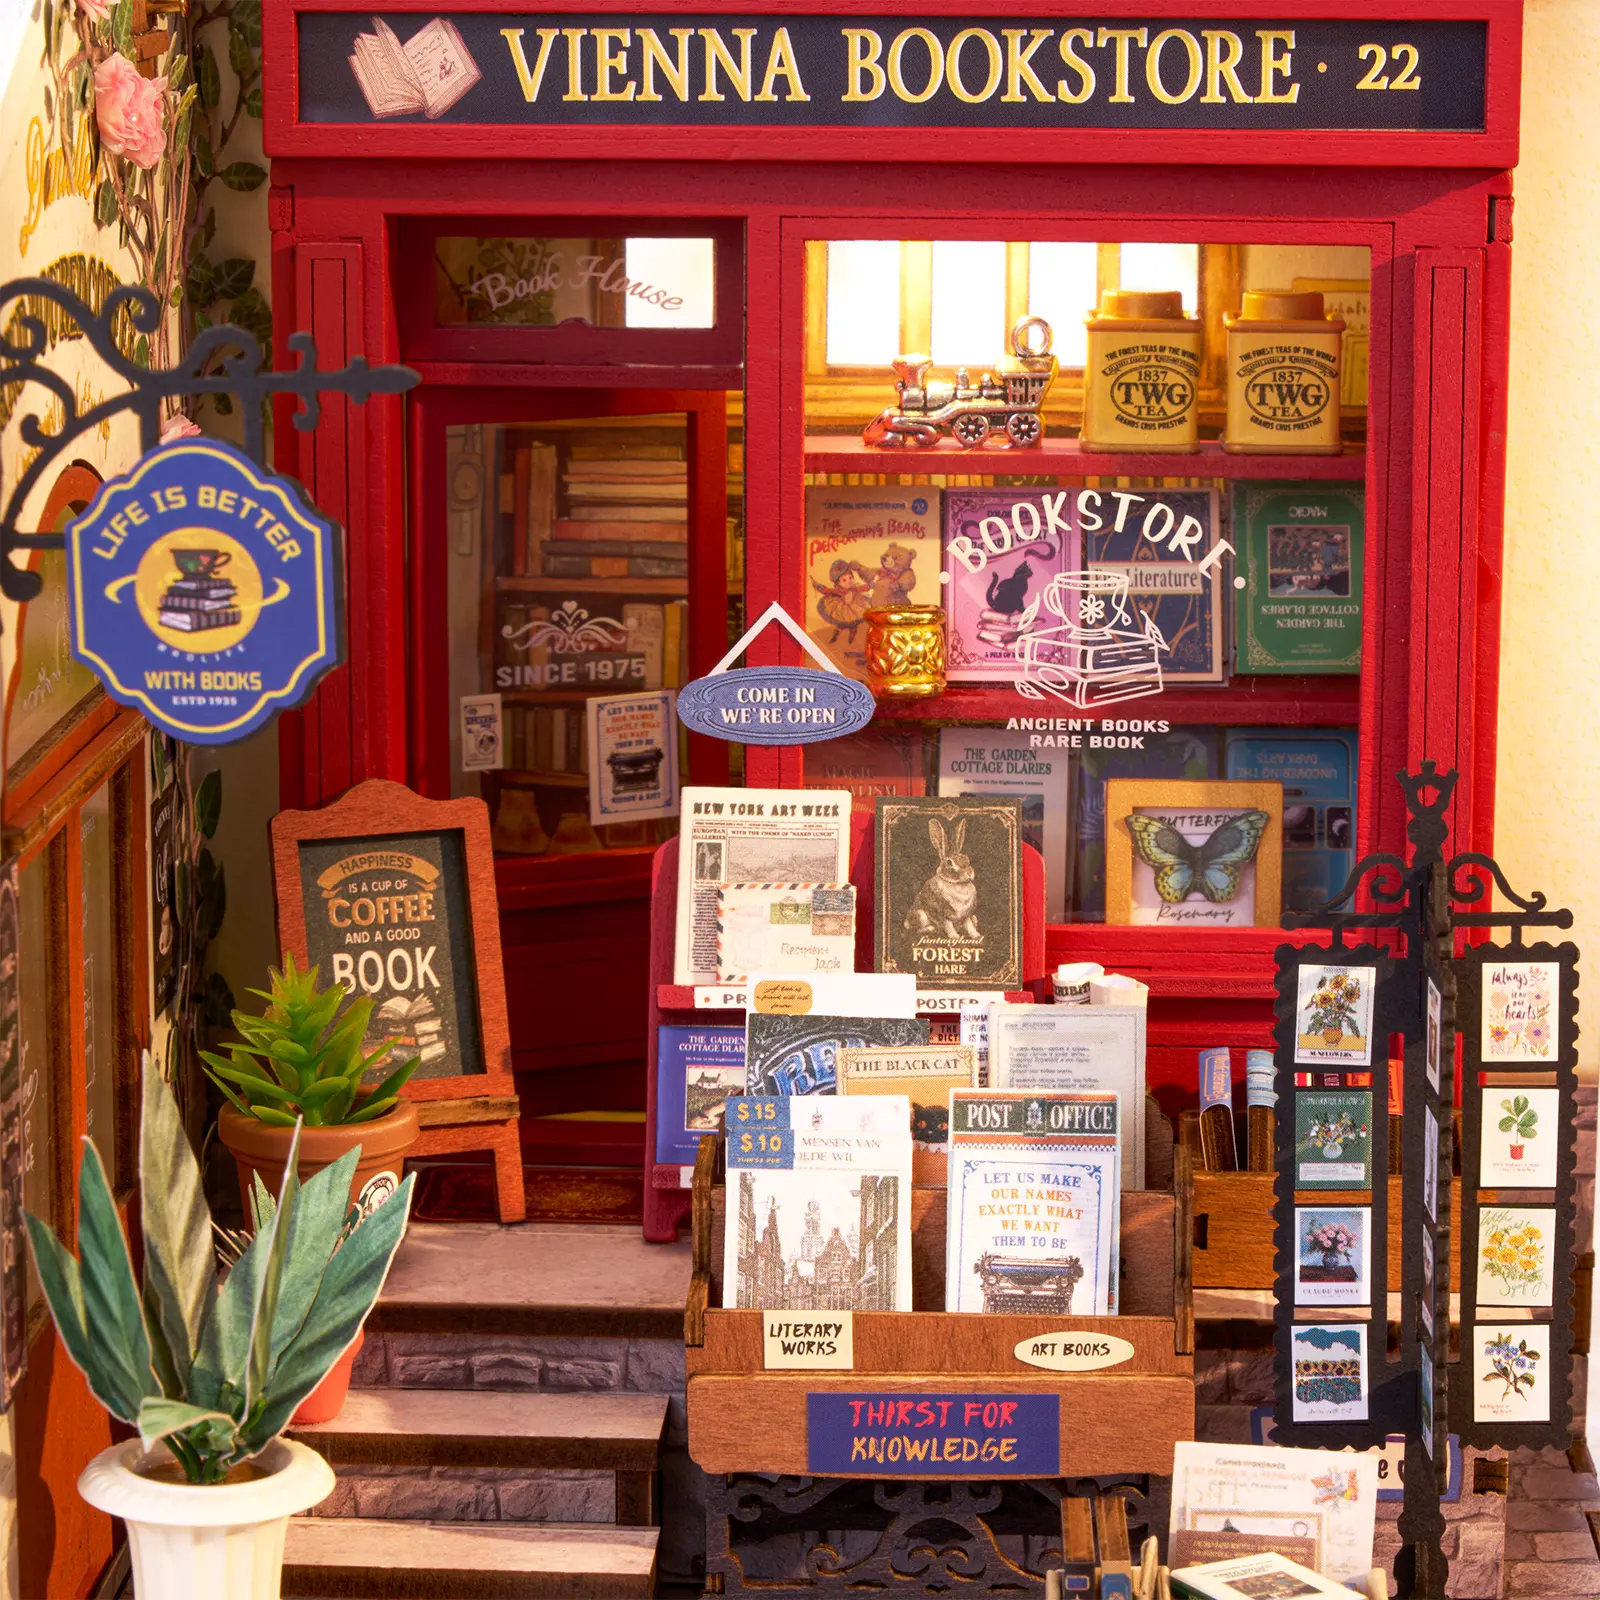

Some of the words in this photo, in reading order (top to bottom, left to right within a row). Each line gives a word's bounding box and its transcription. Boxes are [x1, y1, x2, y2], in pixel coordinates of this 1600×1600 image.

[500, 27, 811, 103] VIENNA
[841, 26, 1301, 105] BOOKSTORE
[1356, 43, 1422, 91] 22
[471, 252, 563, 312] Book
[569, 254, 686, 313] House
[1137, 370, 1168, 382] 1837
[1272, 371, 1303, 383] 1837
[1117, 382, 1189, 406] TWG
[1252, 383, 1324, 407] TWG
[1134, 405, 1169, 417] TEA
[1269, 406, 1303, 417] TEA
[92, 500, 149, 560] LIFE
[150, 485, 187, 514] IS
[197, 486, 302, 563] BETTER
[946, 488, 1237, 580] BOOKSTORE
[1125, 567, 1198, 588] Literature
[144, 671, 196, 690] WITH
[200, 671, 262, 691] BOOKS
[496, 661, 575, 689] SINCE
[583, 657, 647, 683] 1975
[737, 687, 790, 704] COME
[795, 687, 816, 704] IN
[720, 707, 783, 724] WE'RE
[793, 707, 837, 724] OPEN
[1006, 717, 1095, 732] ANCIENT
[1101, 719, 1170, 734] BOOKS
[1029, 733, 1084, 749] RARE
[1089, 735, 1145, 750] BOOK
[964, 747, 985, 760] THE
[991, 748, 1037, 761] GARDEN
[951, 760, 1004, 774] COTTAGE
[693, 802, 724, 815] NEW
[729, 803, 764, 816] YORK
[770, 804, 796, 817] ART
[801, 804, 840, 817] WEEK
[339, 854, 414, 875] HAPPINESS
[348, 882, 358, 893] IS
[361, 881, 369, 892] A
[371, 880, 392, 892] CUP
[395, 878, 409, 890] OF
[328, 891, 437, 928] COFFEE
[345, 930, 371, 945] AND
[374, 929, 383, 942] A
[386, 927, 421, 942] GOOD
[912, 947, 984, 963] FOREST
[332, 946, 441, 995] BOOK
[935, 964, 967, 975] HARE
[941, 1024, 957, 1033] THE
[679, 1043, 720, 1052] COTTAGE
[722, 1044, 745, 1053] DLAR
[688, 1035, 707, 1044] THE
[710, 1035, 745, 1045] GARDEN
[853, 1060, 882, 1072] THE
[886, 1058, 930, 1071] BLACK
[935, 1057, 961, 1069] CAT
[967, 1103, 1012, 1128] POST
[1050, 1104, 1114, 1130] OFFICE
[984, 1173, 1011, 1184] LET
[1016, 1173, 1035, 1184] US
[1041, 1174, 1082, 1188] MAKE
[991, 1188, 1020, 1200] OUR
[1025, 1189, 1072, 1203] NAMES
[978, 1204, 1040, 1217] EXACTLY
[1046, 1205, 1084, 1220] WHAT
[1001, 1220, 1019, 1231] WE
[1024, 1221, 1060, 1233] WANT
[992, 1235, 1026, 1248] THEM
[1031, 1236, 1047, 1248] TO
[1051, 1237, 1068, 1250] BE
[769, 1321, 843, 1339] LITERARY
[780, 1339, 838, 1356] WORKS
[1031, 1342, 1056, 1357] ART
[1063, 1342, 1111, 1357] BOOKS
[849, 1400, 954, 1429] THIRST
[964, 1400, 1019, 1429] FOR
[851, 1435, 1019, 1464] KNOWLEDGE
